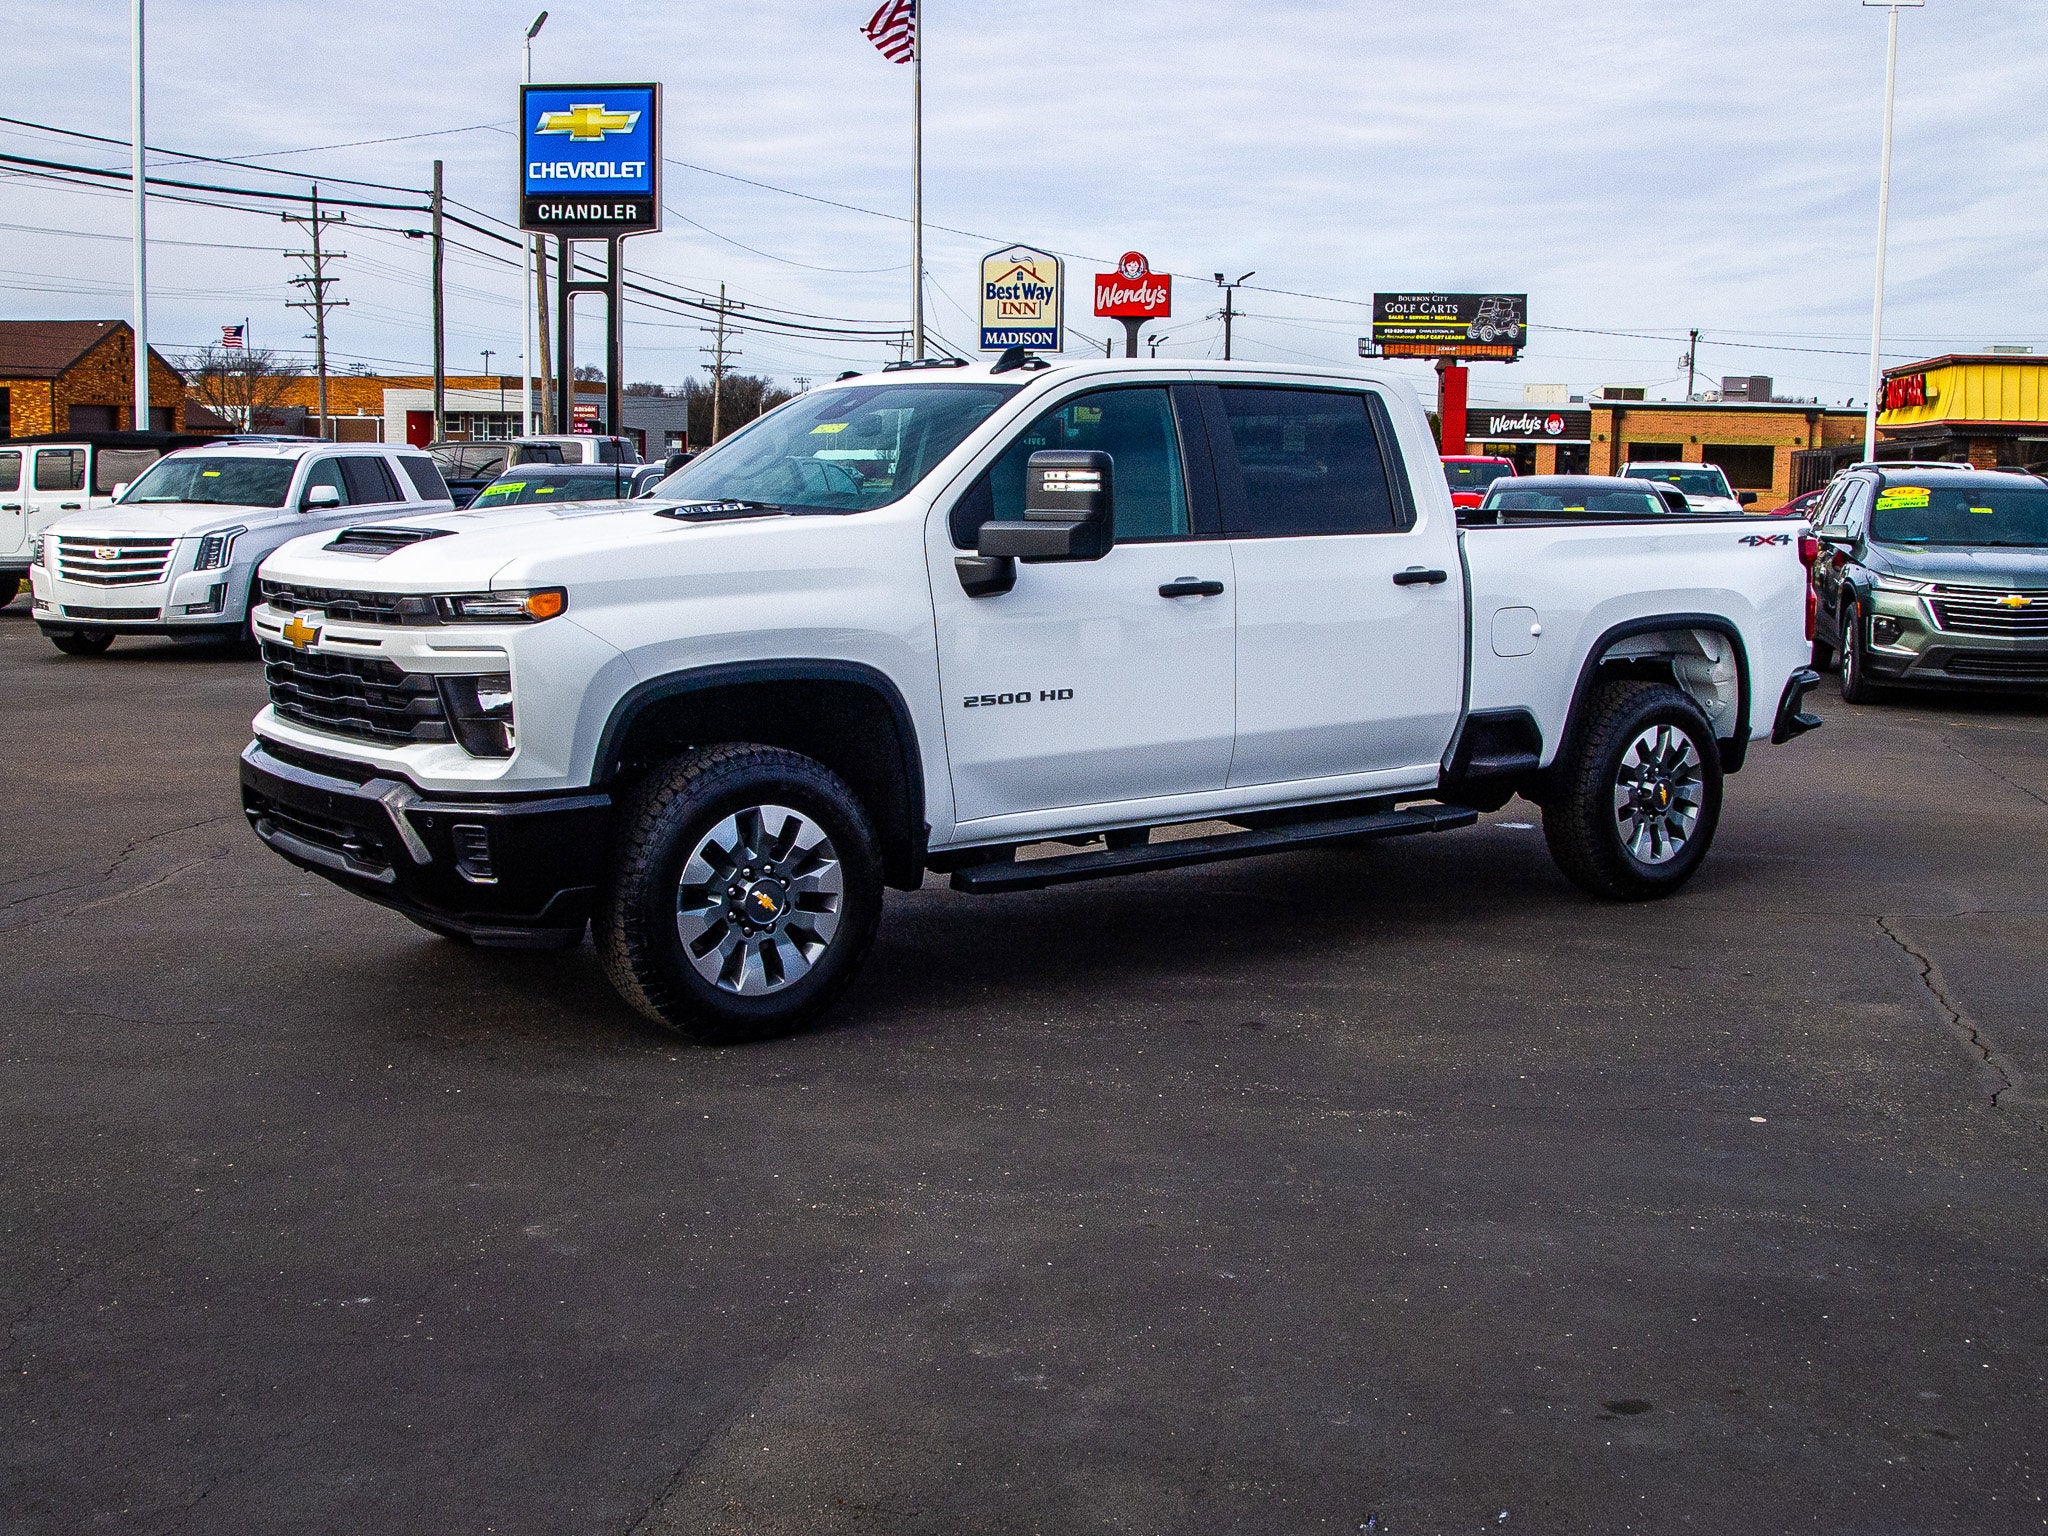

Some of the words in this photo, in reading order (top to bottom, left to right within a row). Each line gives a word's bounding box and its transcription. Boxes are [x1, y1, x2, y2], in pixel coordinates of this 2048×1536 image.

[529, 161, 646, 179] CHEVROLET
[538, 204, 637, 220] CHANDLER
[986, 283, 1020, 300] Best
[1021, 282, 1054, 305] Way
[1096, 281, 1167, 311] Wendy's
[1001, 301, 1037, 315] INN
[1385, 302, 1416, 314] GOLF
[1420, 302, 1459, 314] CARTS
[985, 332, 1054, 345] MADISON
[1489, 413, 1542, 435] Wendy's
[963, 691, 1032, 708] 2500
[1039, 688, 1074, 702] HD
